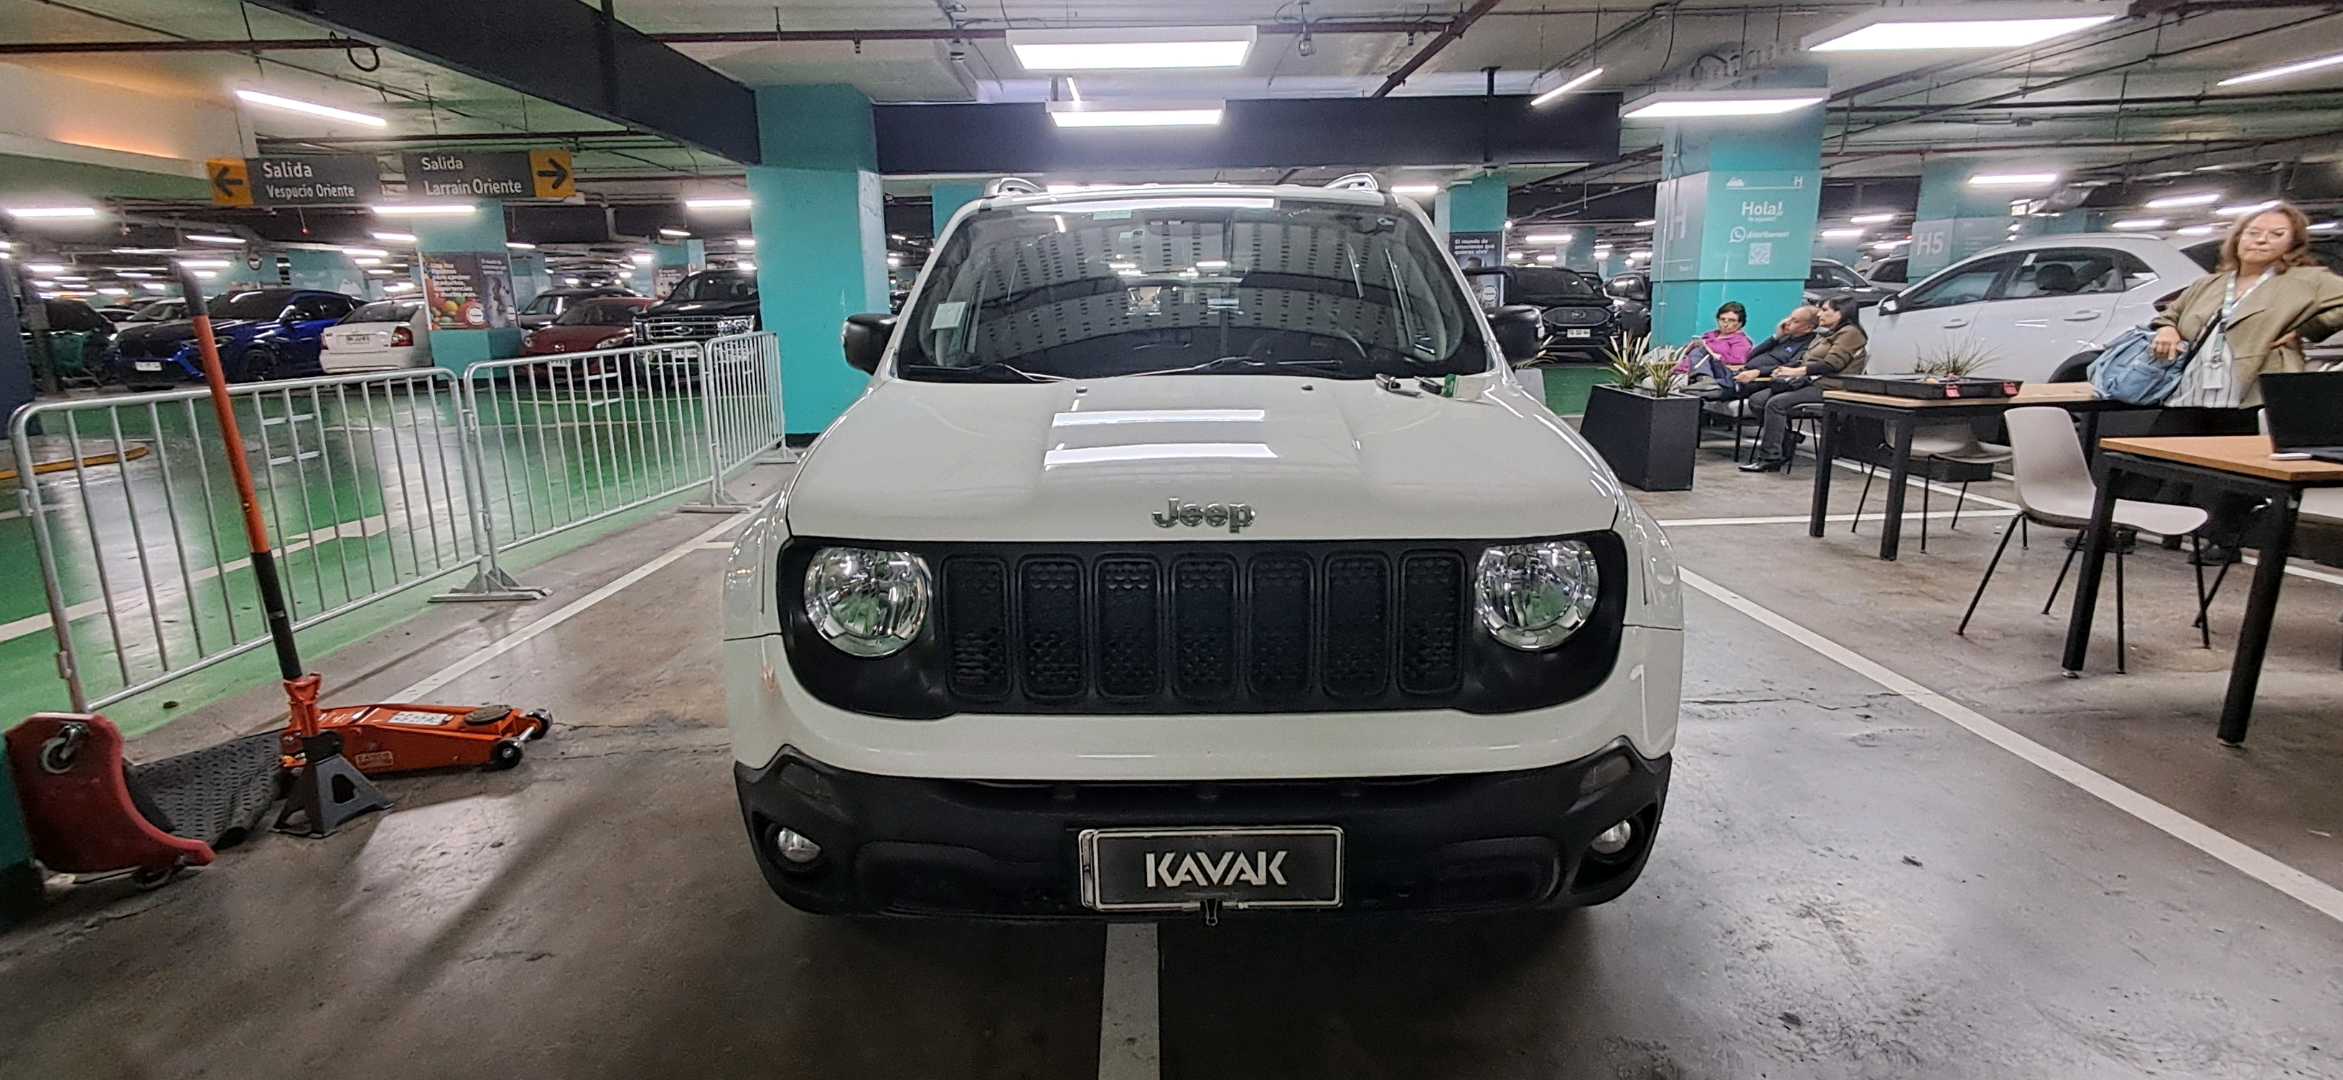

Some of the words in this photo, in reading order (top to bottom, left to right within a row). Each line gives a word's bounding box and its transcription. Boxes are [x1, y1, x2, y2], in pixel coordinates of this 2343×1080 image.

[263, 161, 313, 178] Salida
[421, 156, 464, 170] Salida
[266, 185, 313, 200] Vespucio
[316, 183, 355, 198] Oriente
[473, 178, 522, 194] Oriente
[1742, 201, 1783, 217] Hola!
[1917, 231, 1944, 256] H5
[1152, 498, 1256, 534] Jeep
[1146, 851, 1288, 888] KAVAK
